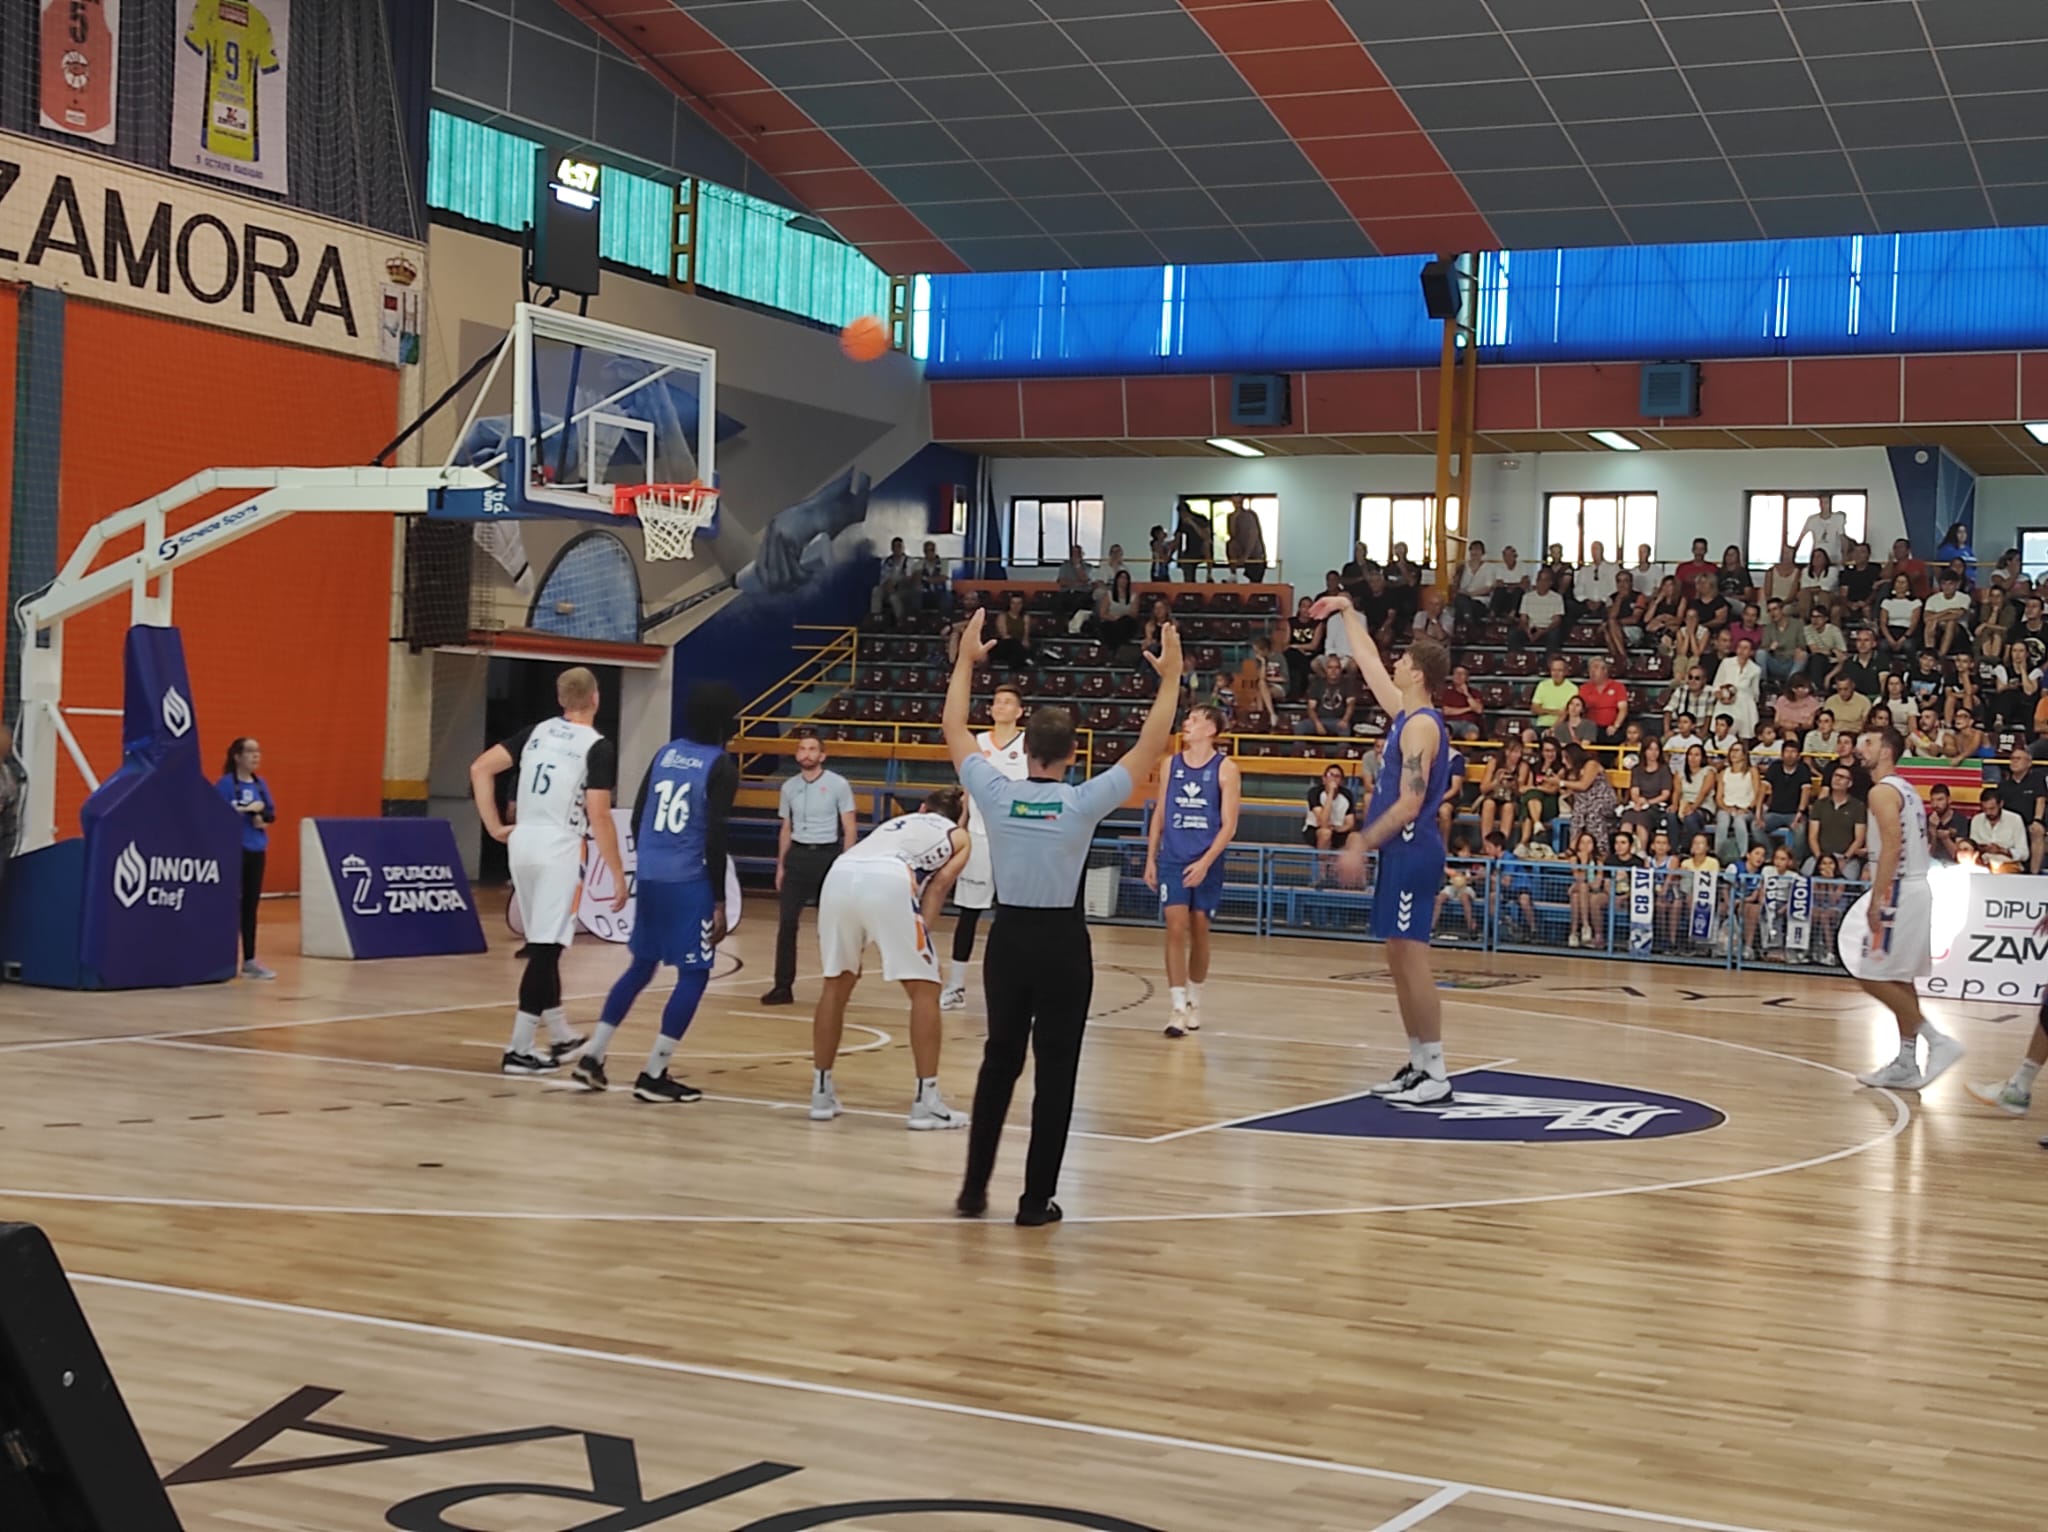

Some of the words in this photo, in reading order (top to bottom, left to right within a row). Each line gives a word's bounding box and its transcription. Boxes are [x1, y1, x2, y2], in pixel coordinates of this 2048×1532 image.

[225, 41, 239, 81] 9
[531, 762, 557, 795] 15
[653, 779, 691, 834] 16
[149, 856, 220, 884] INNOVA
[147, 886, 185, 912] Chef
[384, 889, 468, 913] ZAMORA
